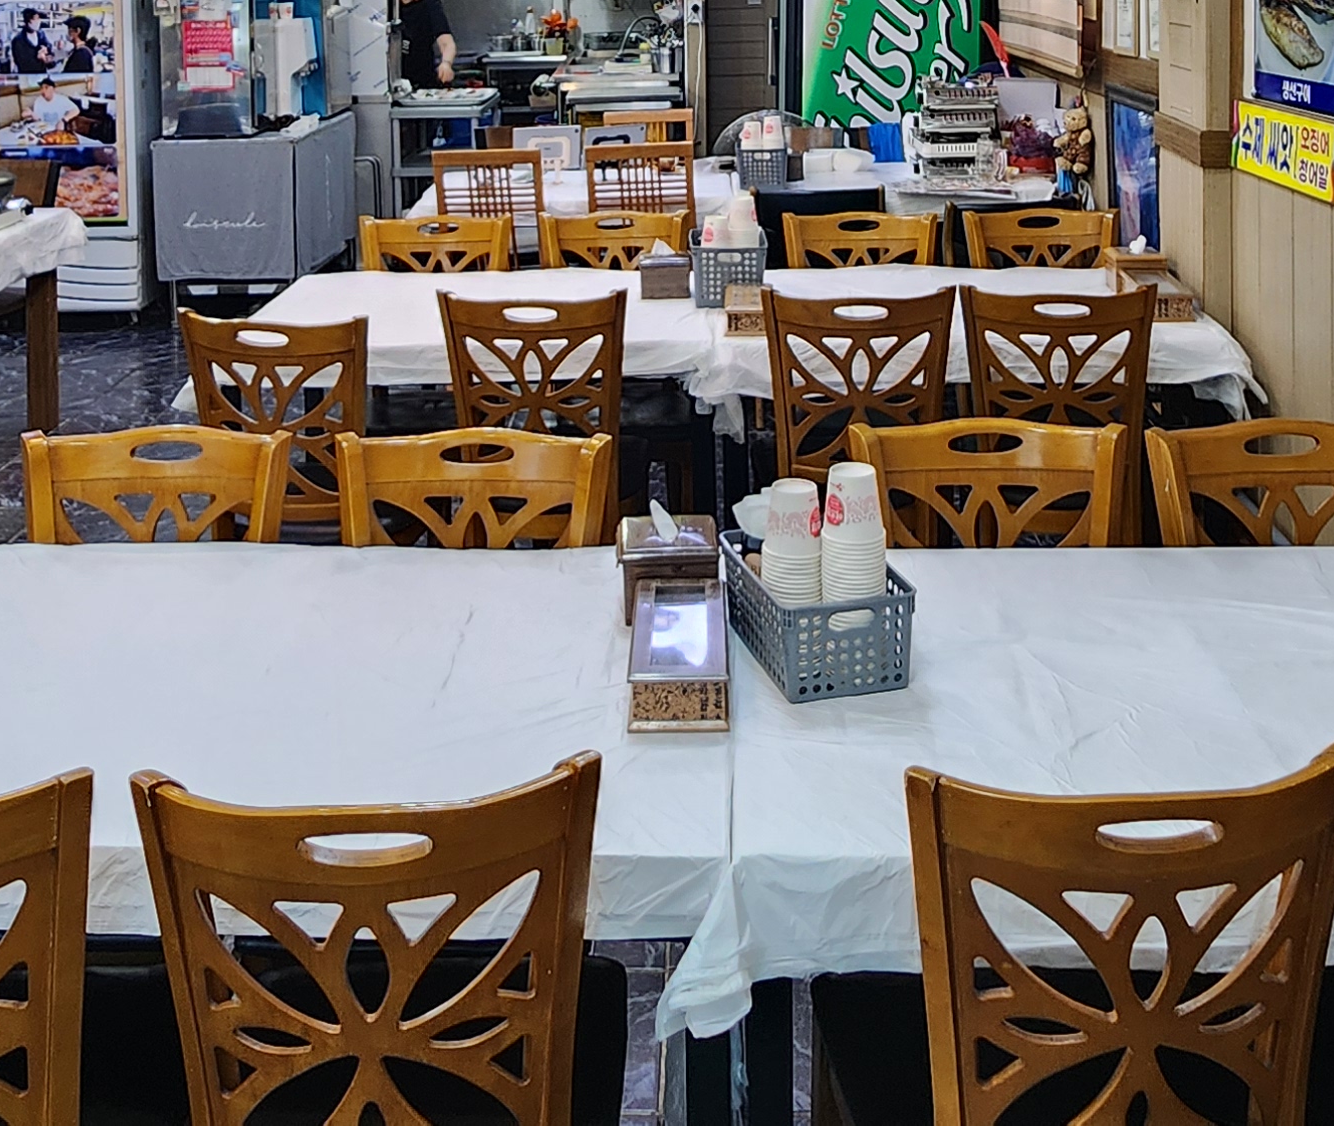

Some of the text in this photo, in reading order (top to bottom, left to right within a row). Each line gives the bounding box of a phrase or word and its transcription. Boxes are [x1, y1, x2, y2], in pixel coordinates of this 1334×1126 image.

[1282, 82, 1312, 104] 생선구이
[1241, 113, 1294, 173] 수제 씨앗
[1300, 124, 1331, 157] 오징어
[1298, 158, 1329, 191] 청어알
